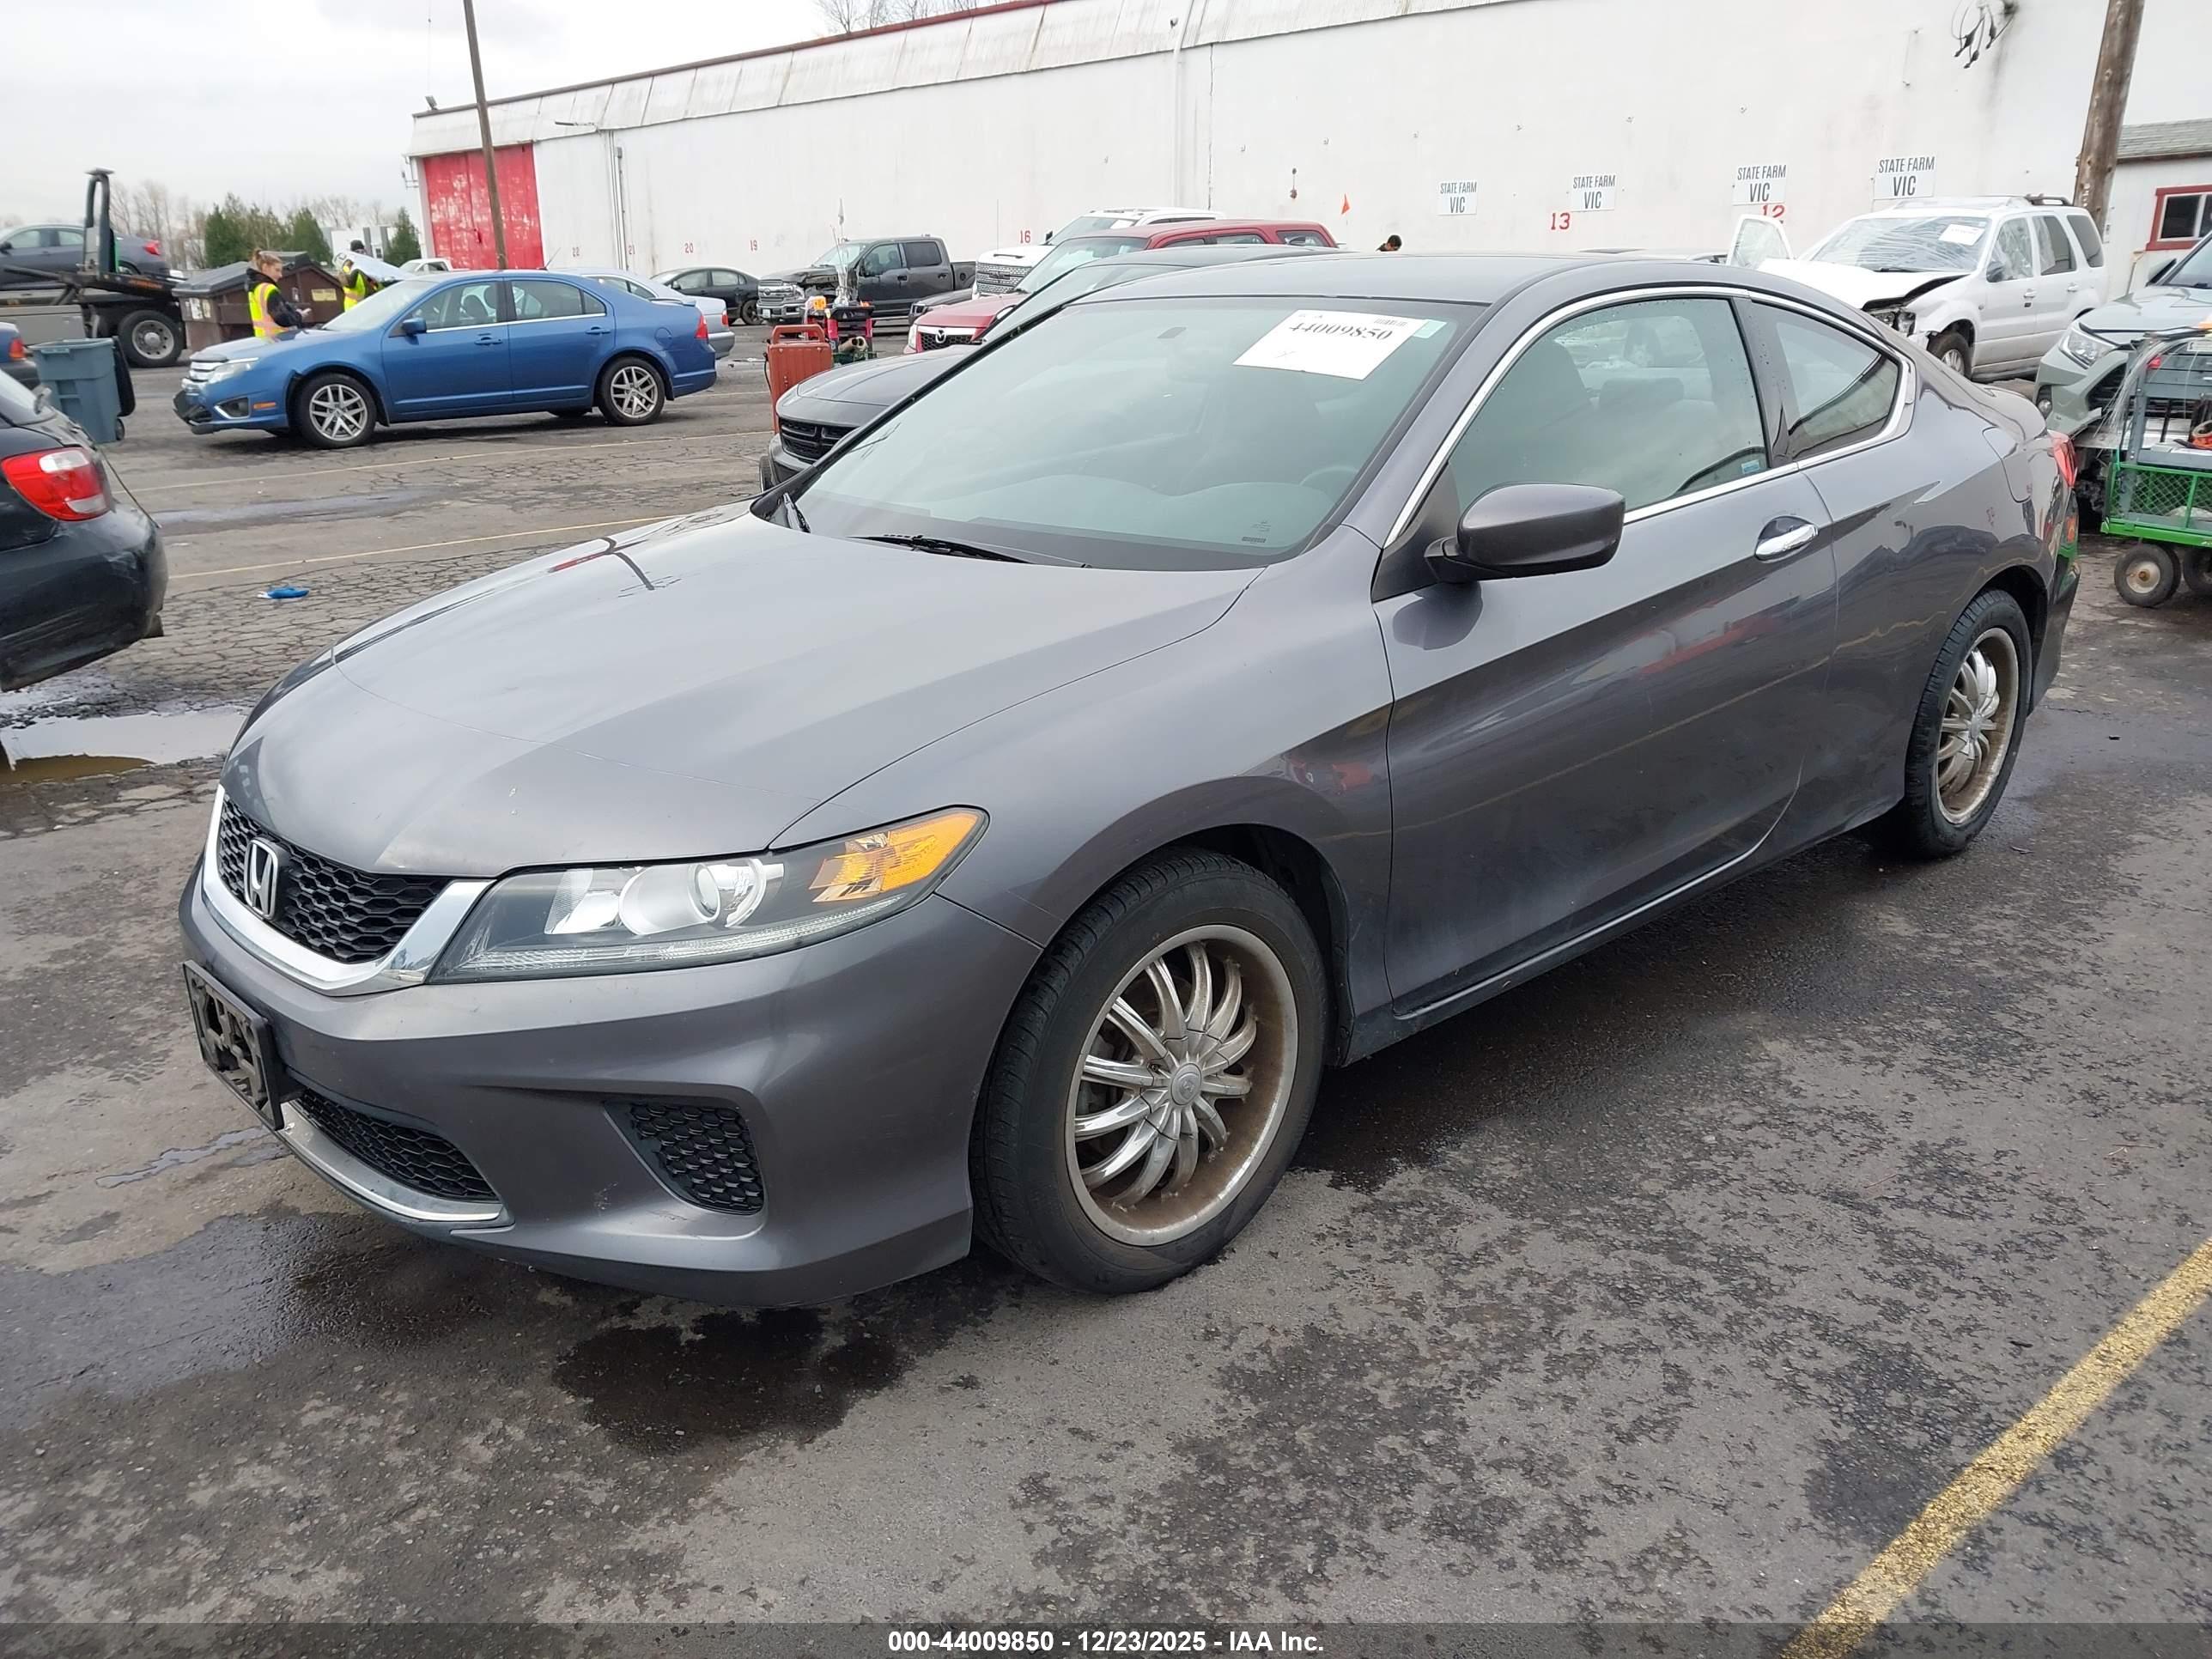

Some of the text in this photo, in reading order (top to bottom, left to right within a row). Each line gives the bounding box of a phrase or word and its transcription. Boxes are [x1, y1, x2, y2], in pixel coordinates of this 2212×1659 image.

[1737, 164, 1787, 180] STATE FARM
[1878, 156, 1935, 173] STATE FARM
[1440, 181, 1477, 194] STATE FARM
[1573, 174, 1616, 189] STATE FARM
[1893, 175, 1917, 196] VIC
[1583, 191, 1602, 210] VIC
[1749, 182, 1771, 202] VIC
[1449, 196, 1466, 213] VIC
[1550, 212, 1571, 230] 13
[1019, 230, 1031, 244] 16
[684, 242, 694, 253] 20
[750, 240, 758, 252] 19
[1289, 322, 1393, 340] 44009850
